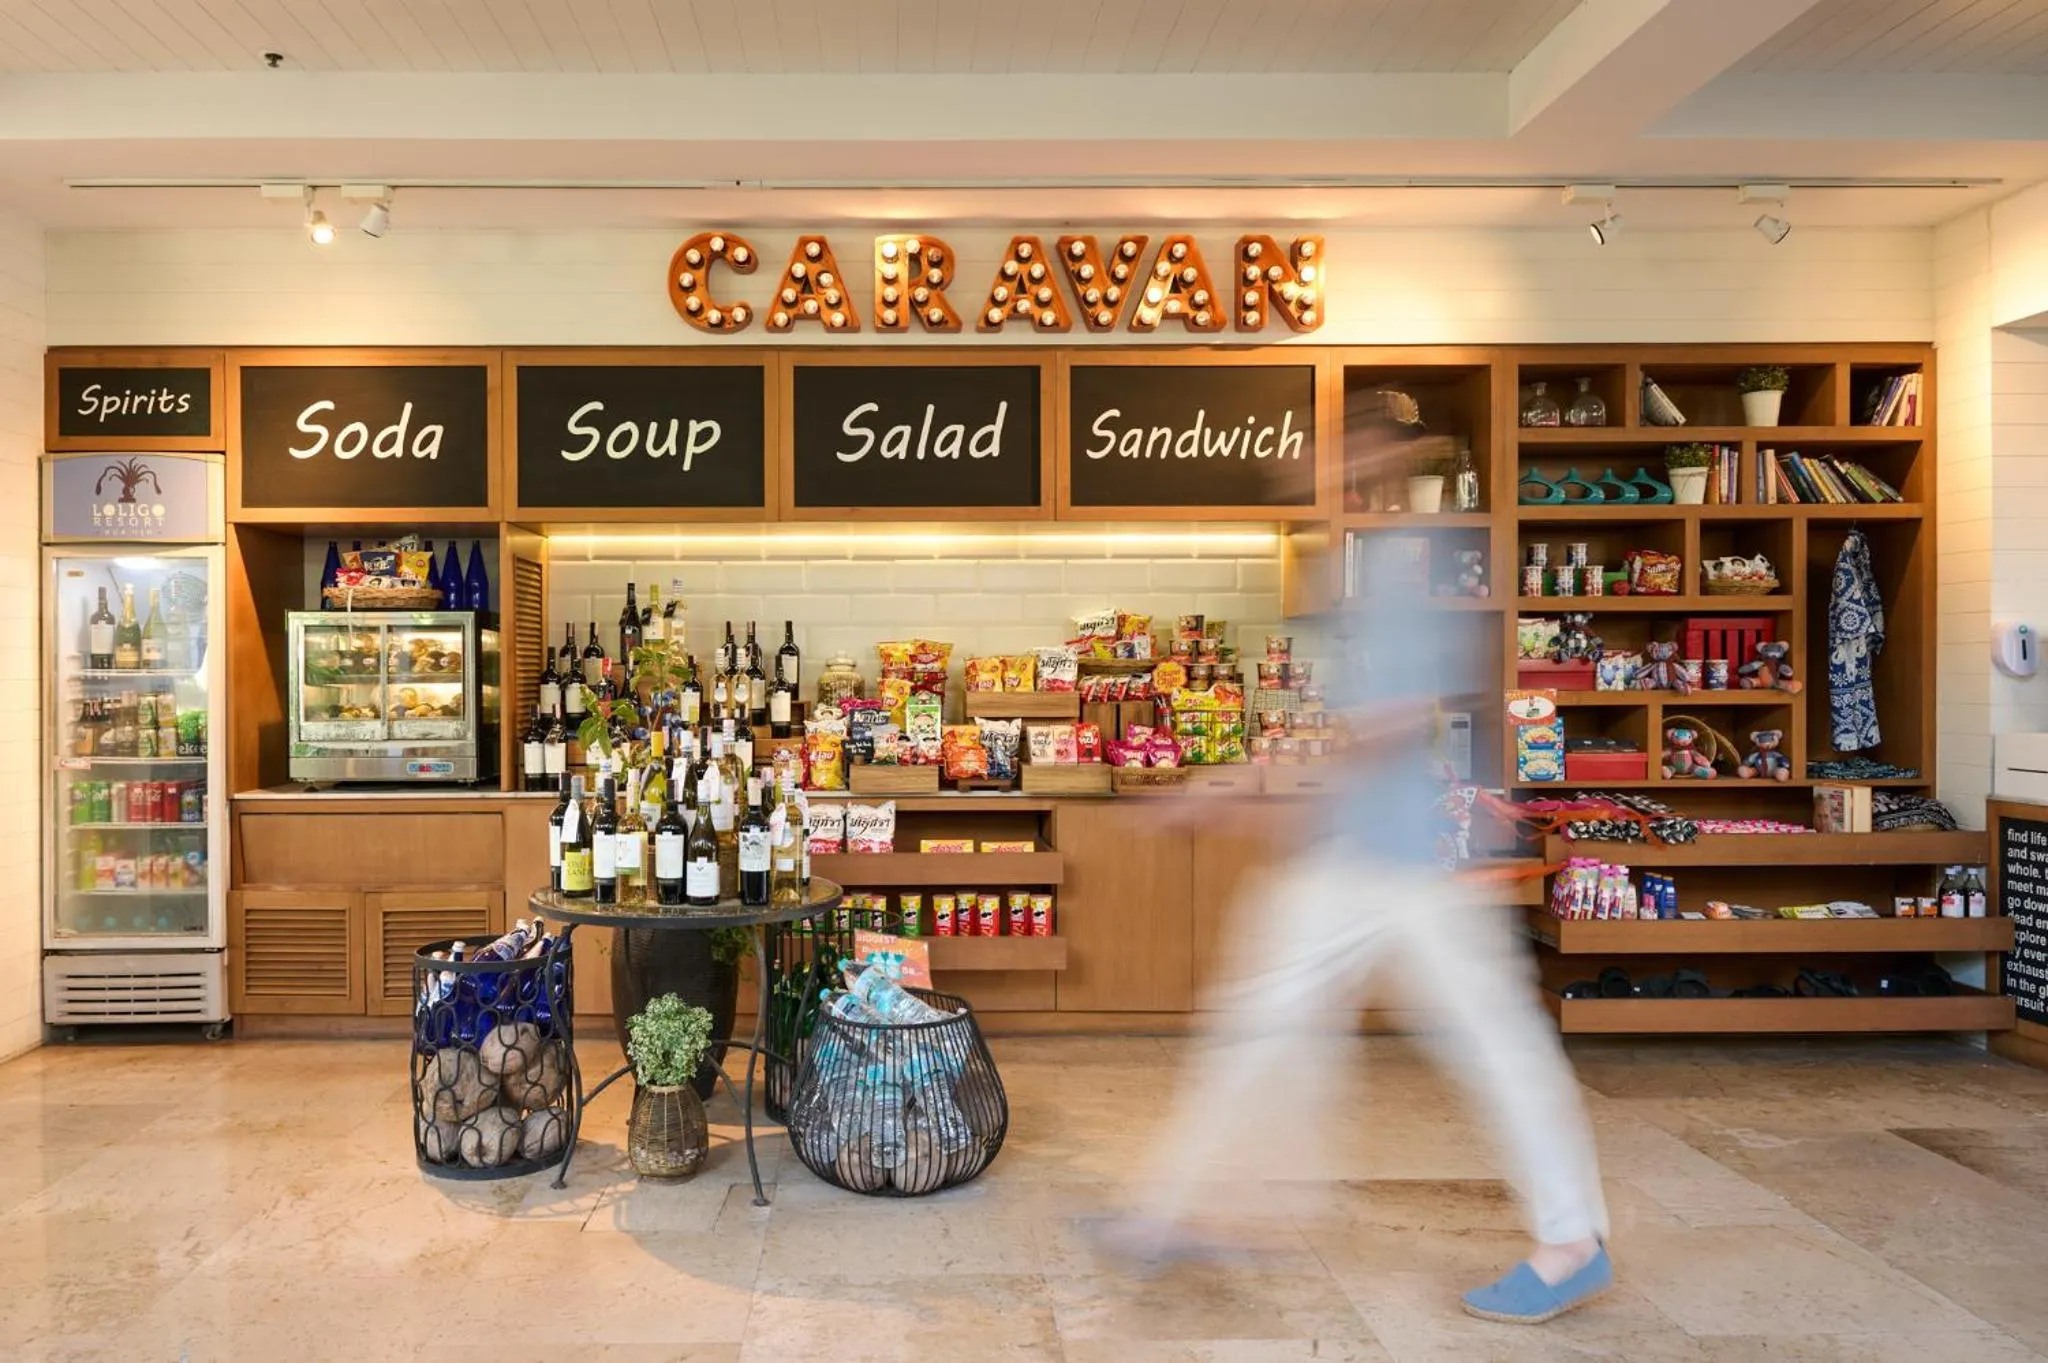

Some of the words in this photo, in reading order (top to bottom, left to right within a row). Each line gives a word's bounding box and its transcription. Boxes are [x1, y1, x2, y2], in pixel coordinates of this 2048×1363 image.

[668, 234, 1325, 333] CARAVAN
[79, 384, 191, 422] Spirits
[289, 400, 445, 460] Soda
[562, 402, 723, 473] Soup
[837, 402, 1009, 464] Salad
[1087, 409, 1304, 460] Sandwich
[92, 503, 165, 517] LOLIGO
[92, 517, 164, 528] RESORT
[2007, 828, 2028, 843] find
[2030, 831, 2047, 846] life
[2007, 847, 2028, 860] and
[2007, 862, 2042, 879] whole.
[2007, 880, 2034, 894] meet
[2007, 896, 2022, 909] go
[2015, 929, 2047, 946] plore
[2019, 978, 2036, 994] the
